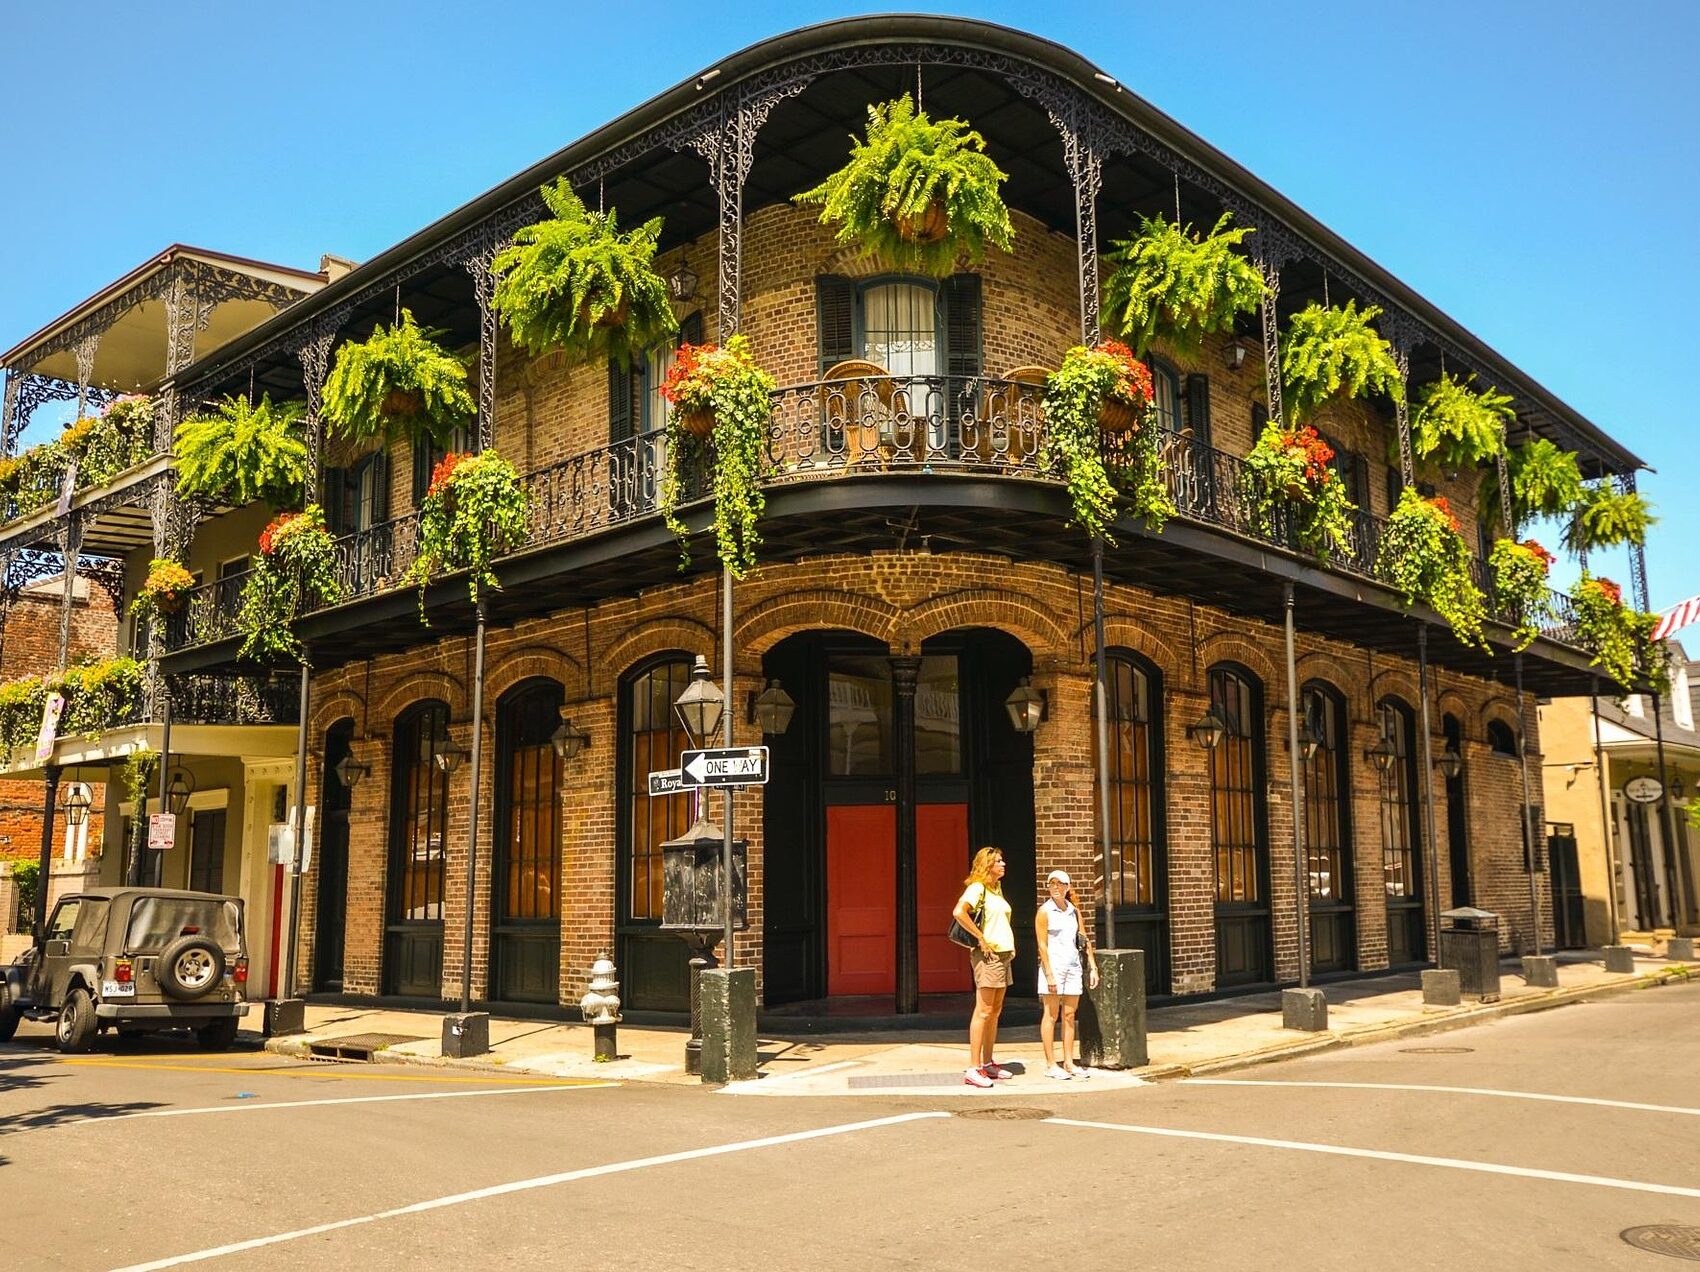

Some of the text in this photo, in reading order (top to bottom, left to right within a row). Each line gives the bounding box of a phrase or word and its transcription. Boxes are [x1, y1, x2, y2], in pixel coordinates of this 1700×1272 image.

[706, 760, 728, 774] ONE
[660, 778, 682, 791] Roya
[884, 790, 897, 801] 10
